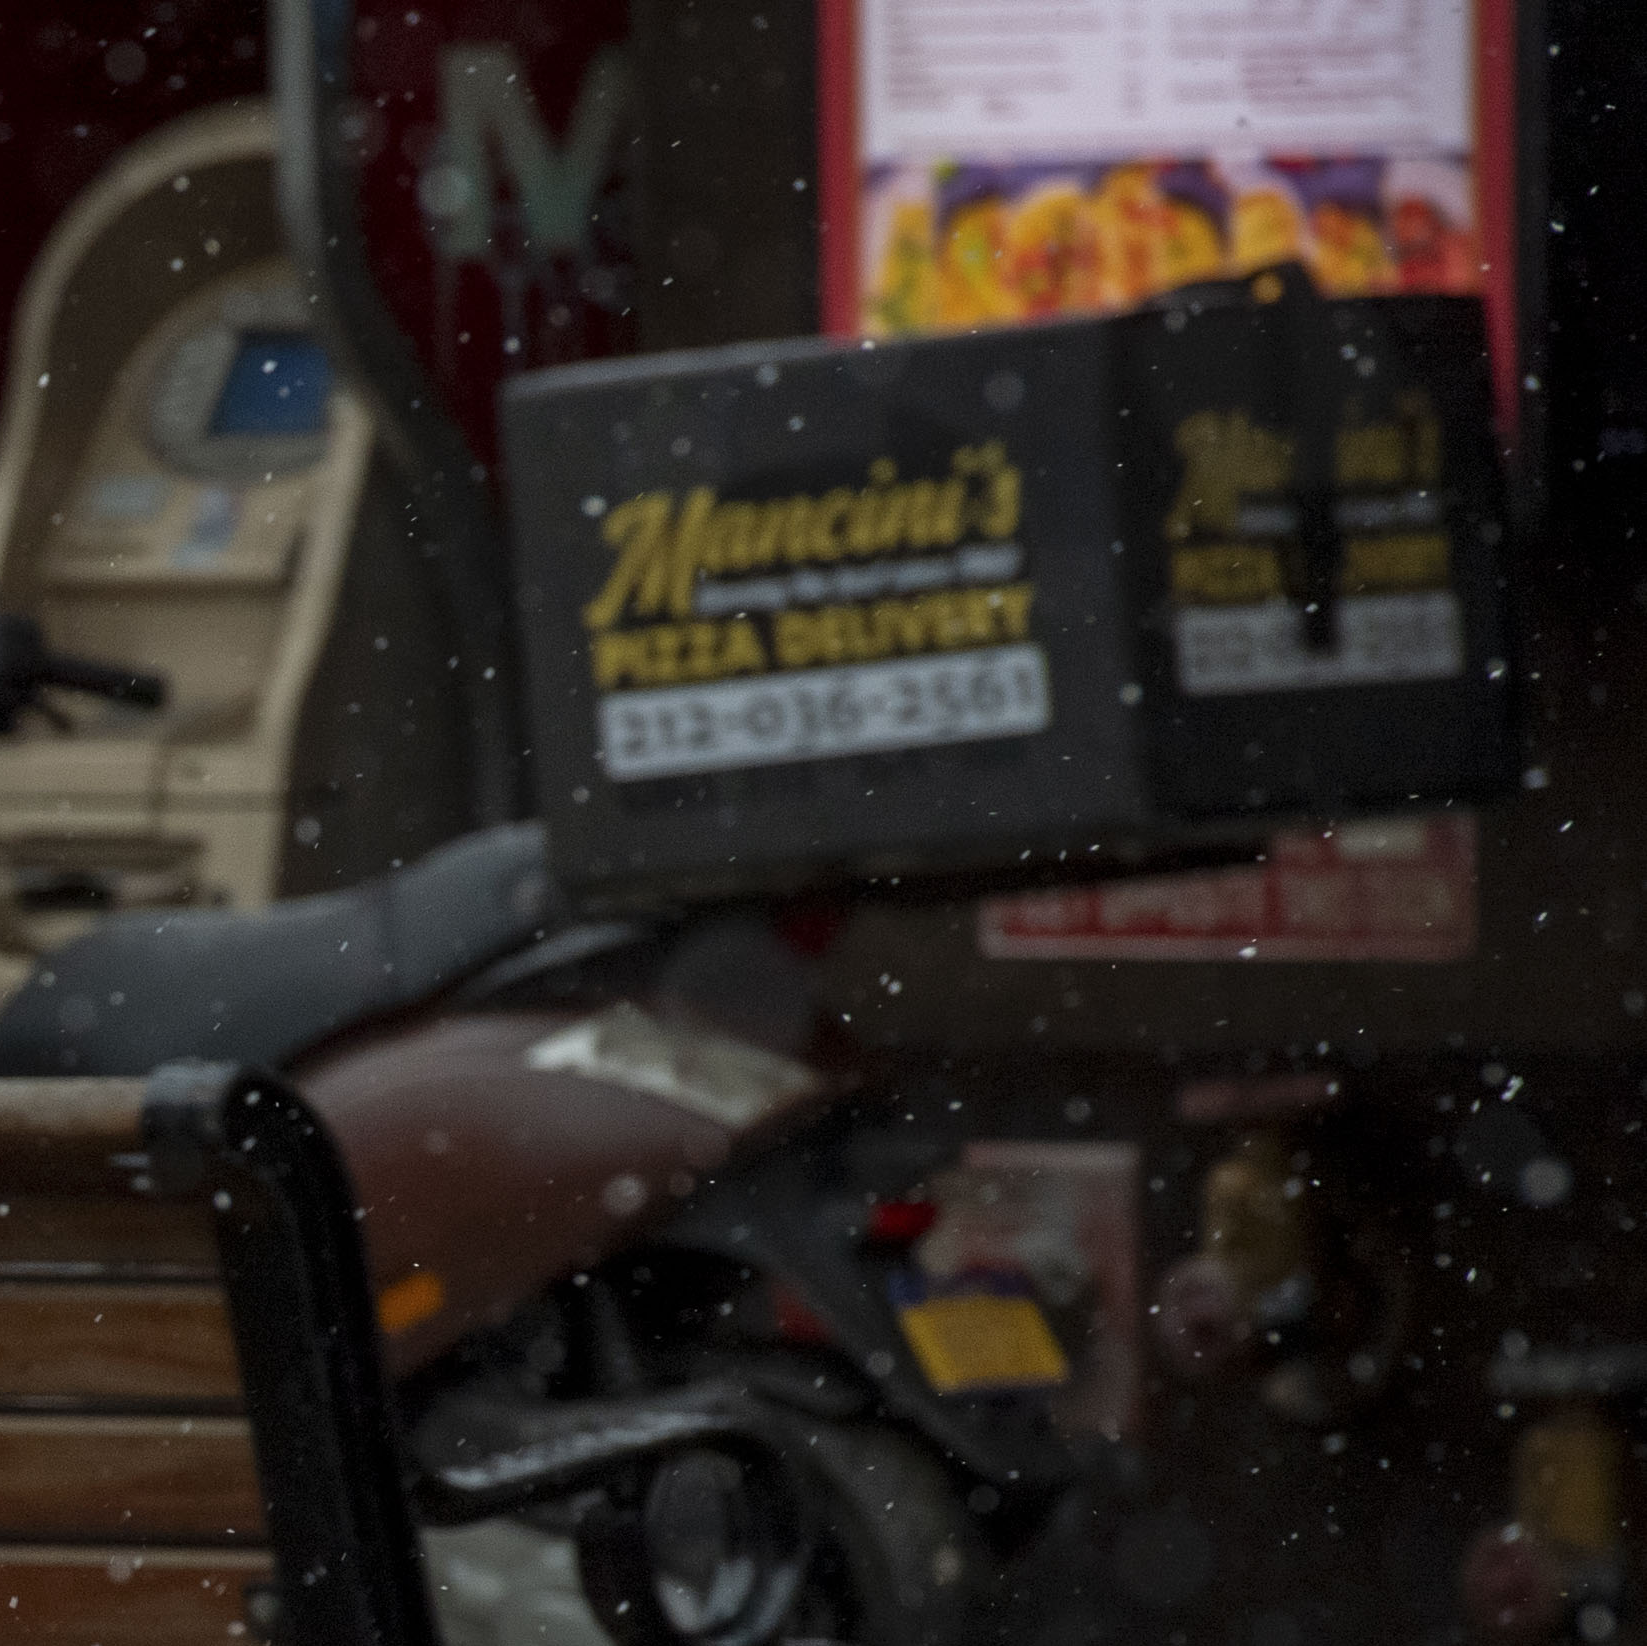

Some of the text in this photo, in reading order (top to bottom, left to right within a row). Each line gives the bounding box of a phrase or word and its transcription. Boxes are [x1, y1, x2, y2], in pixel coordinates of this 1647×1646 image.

[583, 438, 1025, 628] Mancini's
[591, 617, 767, 692] PIZZA
[773, 578, 1035, 668] DELIVERY
